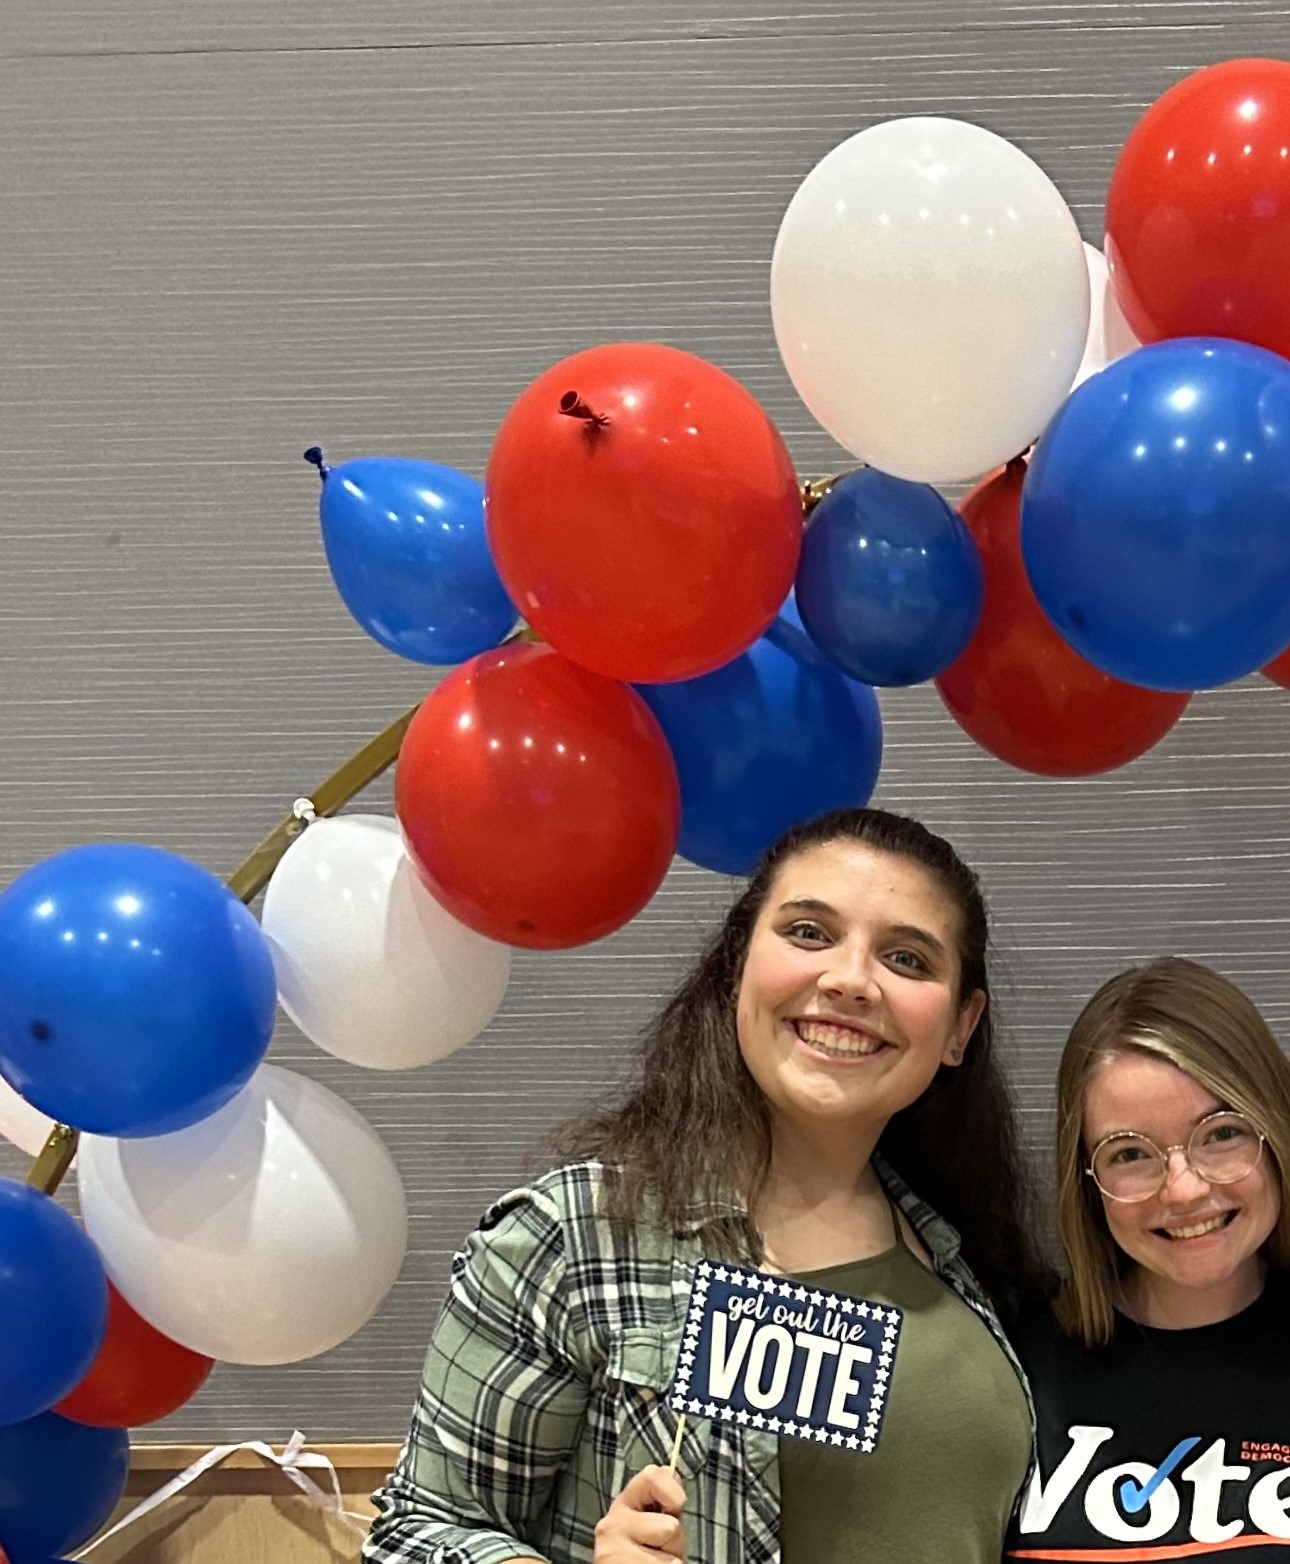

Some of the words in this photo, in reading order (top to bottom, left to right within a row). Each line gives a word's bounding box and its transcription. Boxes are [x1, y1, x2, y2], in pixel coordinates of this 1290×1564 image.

[728, 1293, 769, 1321] get
[773, 1305, 819, 1332] out
[823, 1310, 867, 1342] the
[708, 1311, 873, 1430] VOTE
